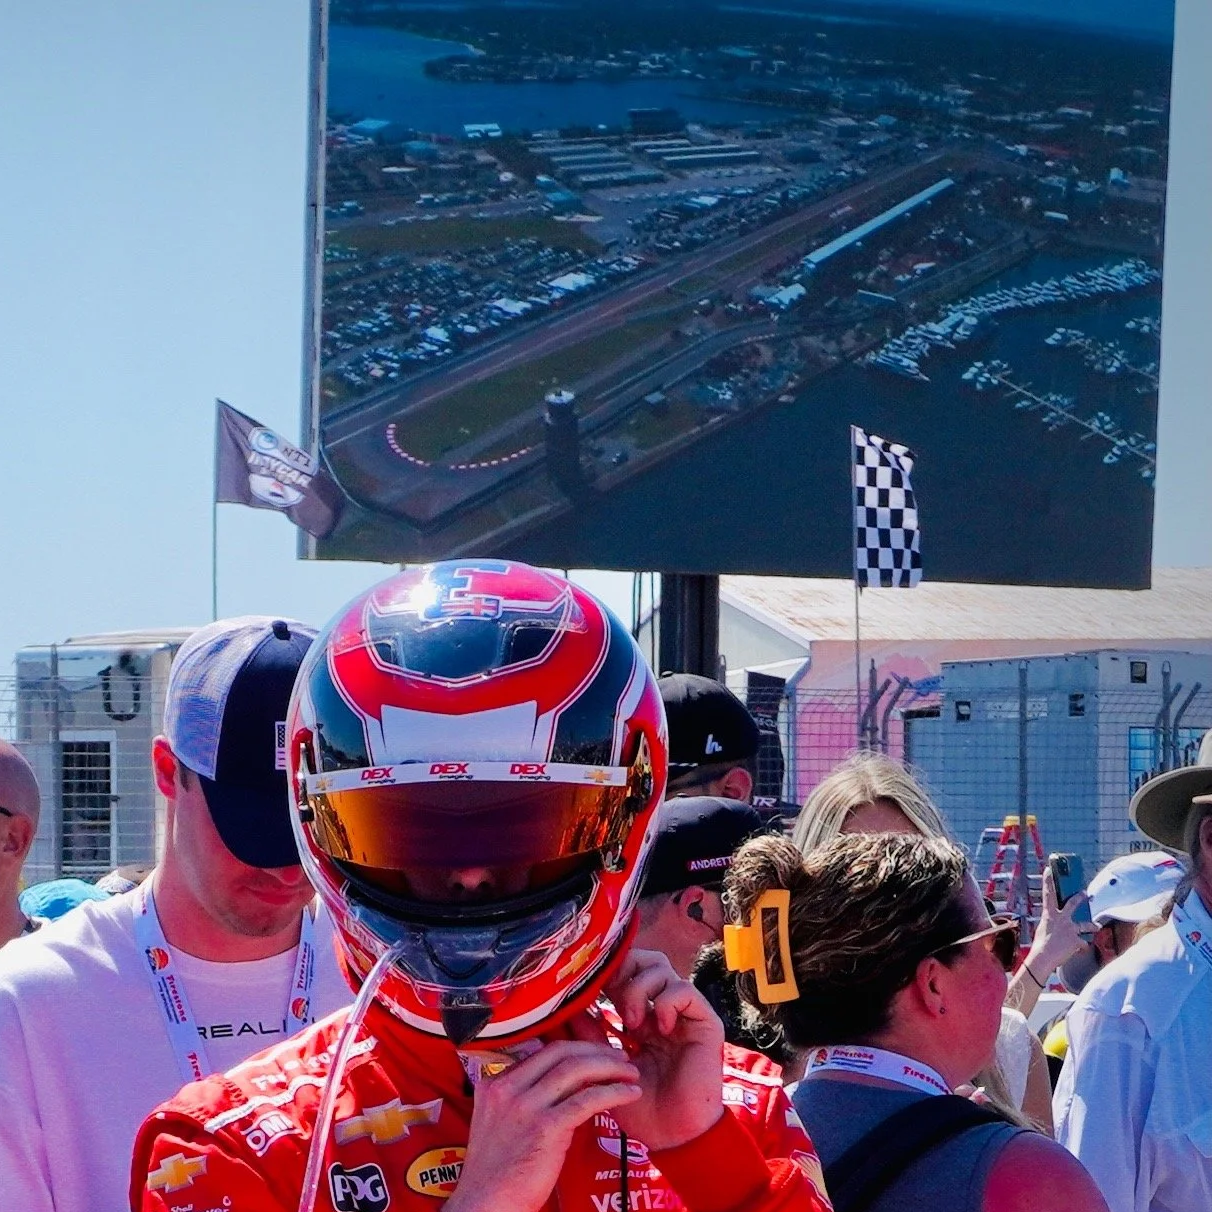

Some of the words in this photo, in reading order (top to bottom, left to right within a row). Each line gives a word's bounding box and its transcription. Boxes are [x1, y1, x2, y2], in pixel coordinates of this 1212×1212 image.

[361, 767, 394, 780] DEX
[429, 763, 470, 775] DEX
[510, 763, 548, 775] DEX
[165, 974, 187, 1023] Firestone
[722, 1087, 759, 1106] MP
[334, 1174, 385, 1210] PPG
